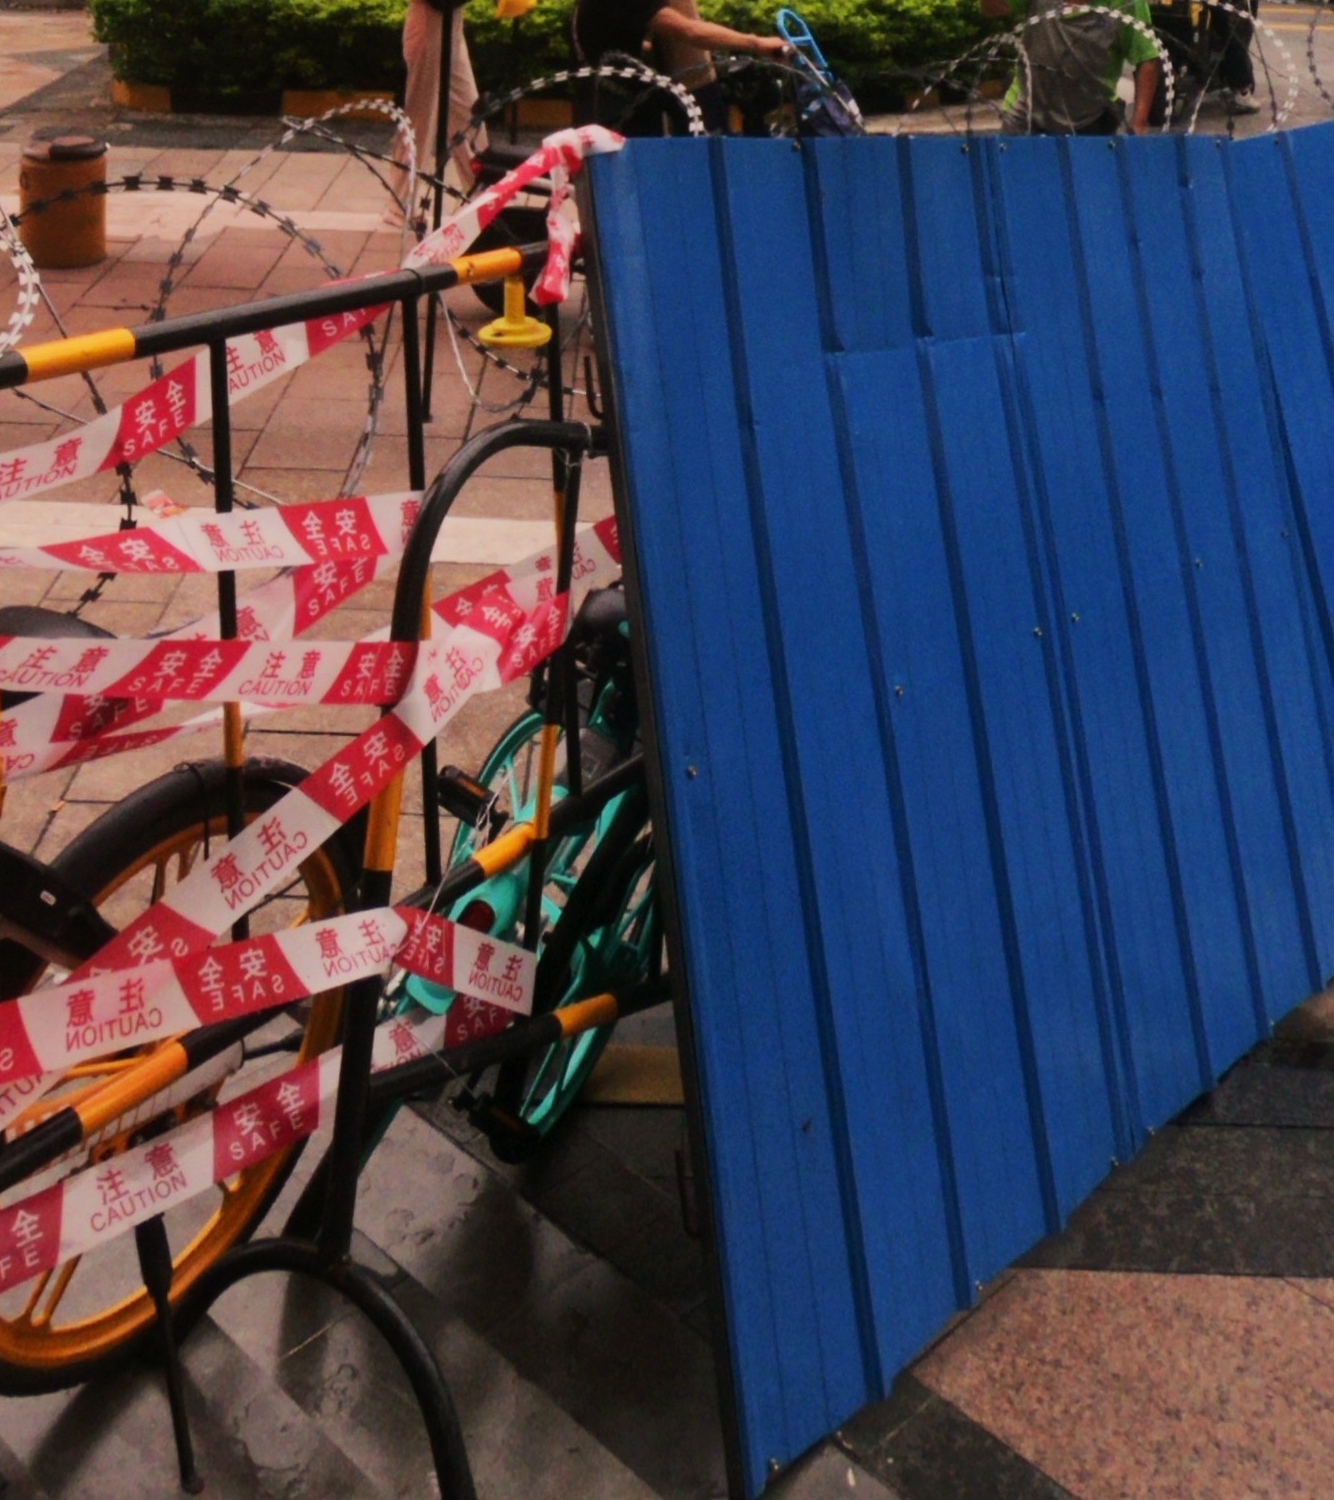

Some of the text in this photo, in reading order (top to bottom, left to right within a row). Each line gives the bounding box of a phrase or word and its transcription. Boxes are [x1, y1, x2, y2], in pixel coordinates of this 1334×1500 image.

[228, 349, 286, 393] AUTION
[135, 380, 187, 434] 安全
[123, 407, 187, 457] SAFE
[307, 564, 365, 617] SAFE
[20, 645, 110, 674] 注意
[154, 647, 223, 678] 安全
[260, 650, 321, 680] 注意
[356, 650, 405, 681] 安全
[128, 676, 208, 694] SAFE
[238, 679, 313, 697] CAUTION
[340, 678, 397, 698] SAFE
[232, 1079, 306, 1137] 安全
[229, 1108, 304, 1162] SAFE
[95, 1140, 176, 1206] 注意
[90, 1170, 187, 1234] CAUTION
